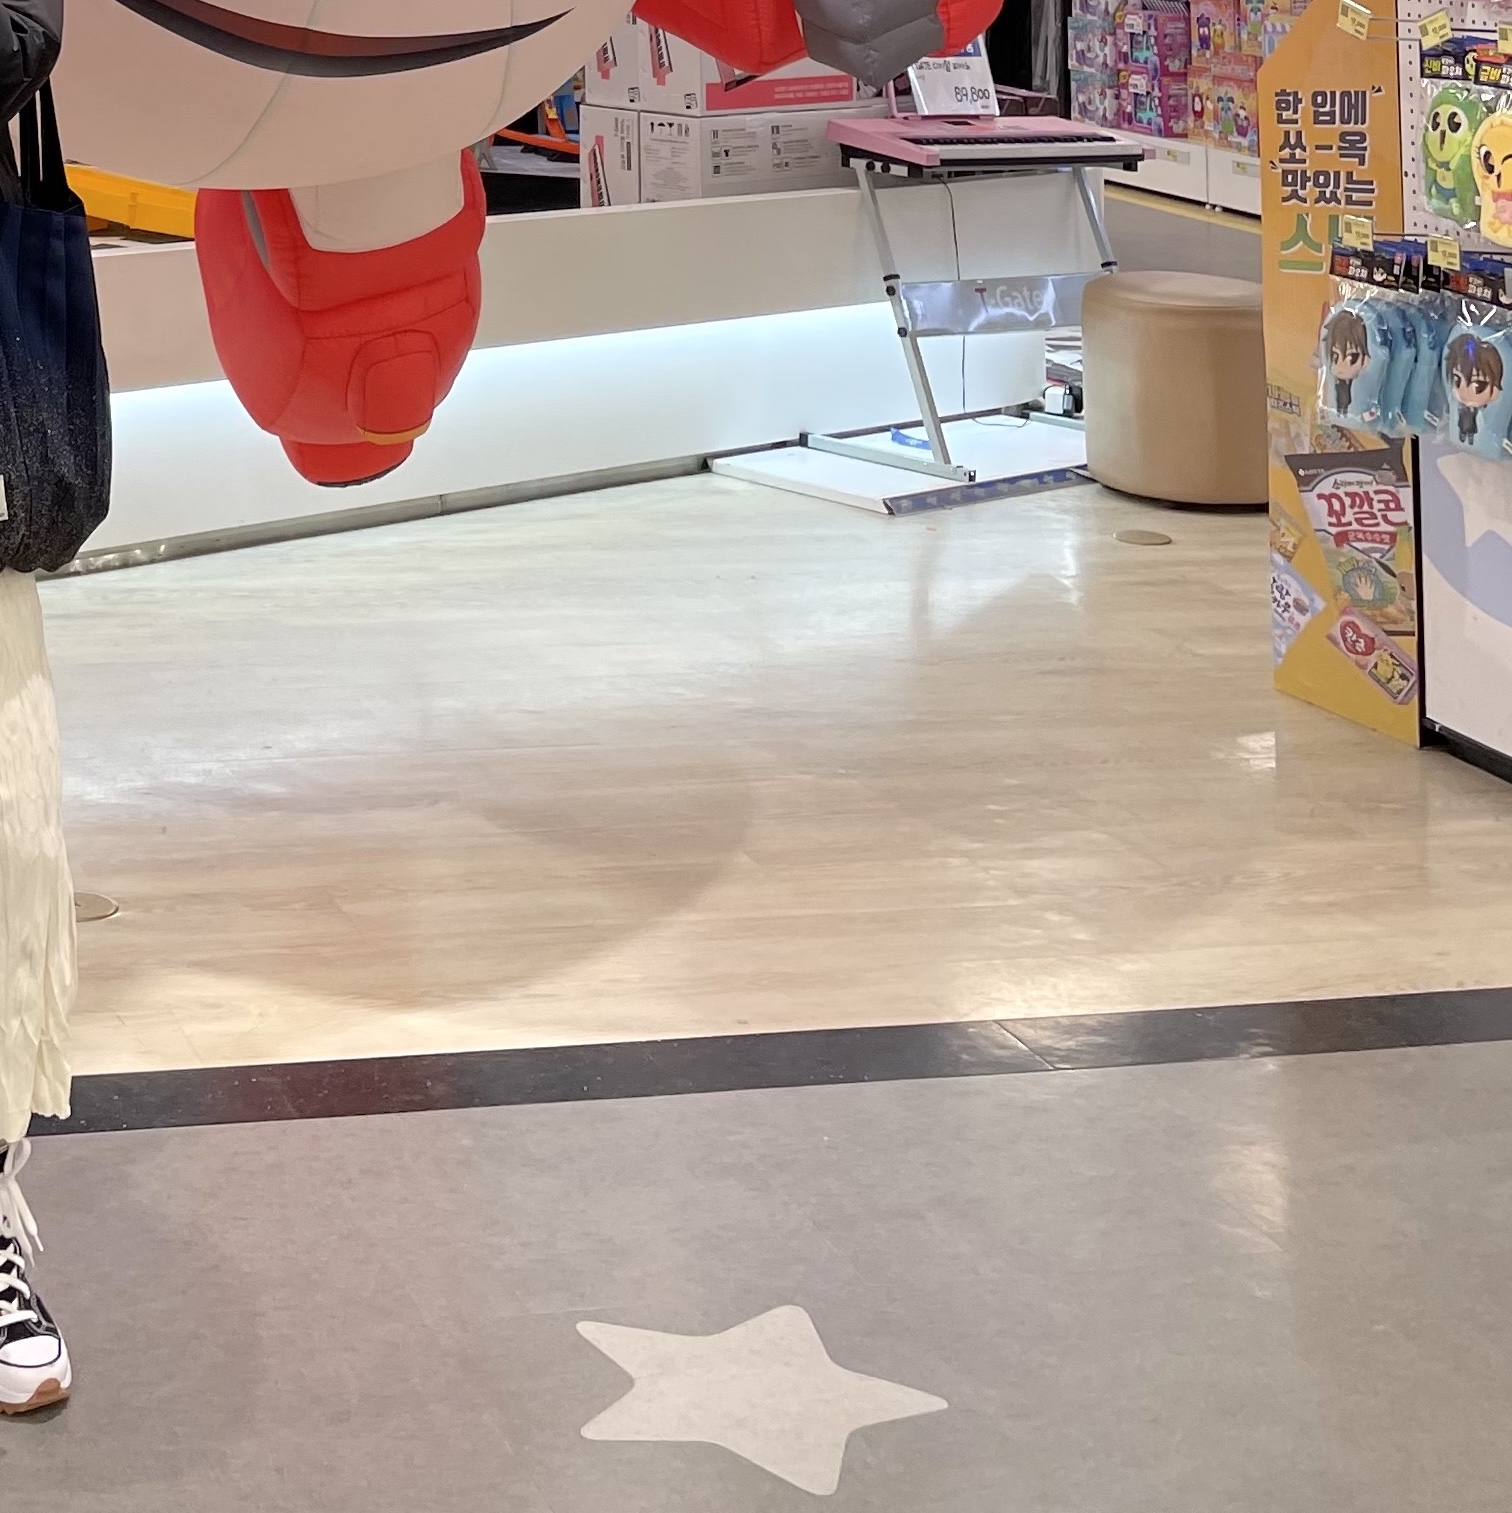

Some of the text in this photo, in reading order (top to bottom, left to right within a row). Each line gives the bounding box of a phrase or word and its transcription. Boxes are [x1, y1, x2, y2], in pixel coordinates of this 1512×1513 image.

[954, 86, 990, 104] 89,800
[1275, 89, 1367, 126] 한 입에
[1281, 169, 1376, 207] 맛있는
[1316, 488, 1410, 528] 꼬깔콘
